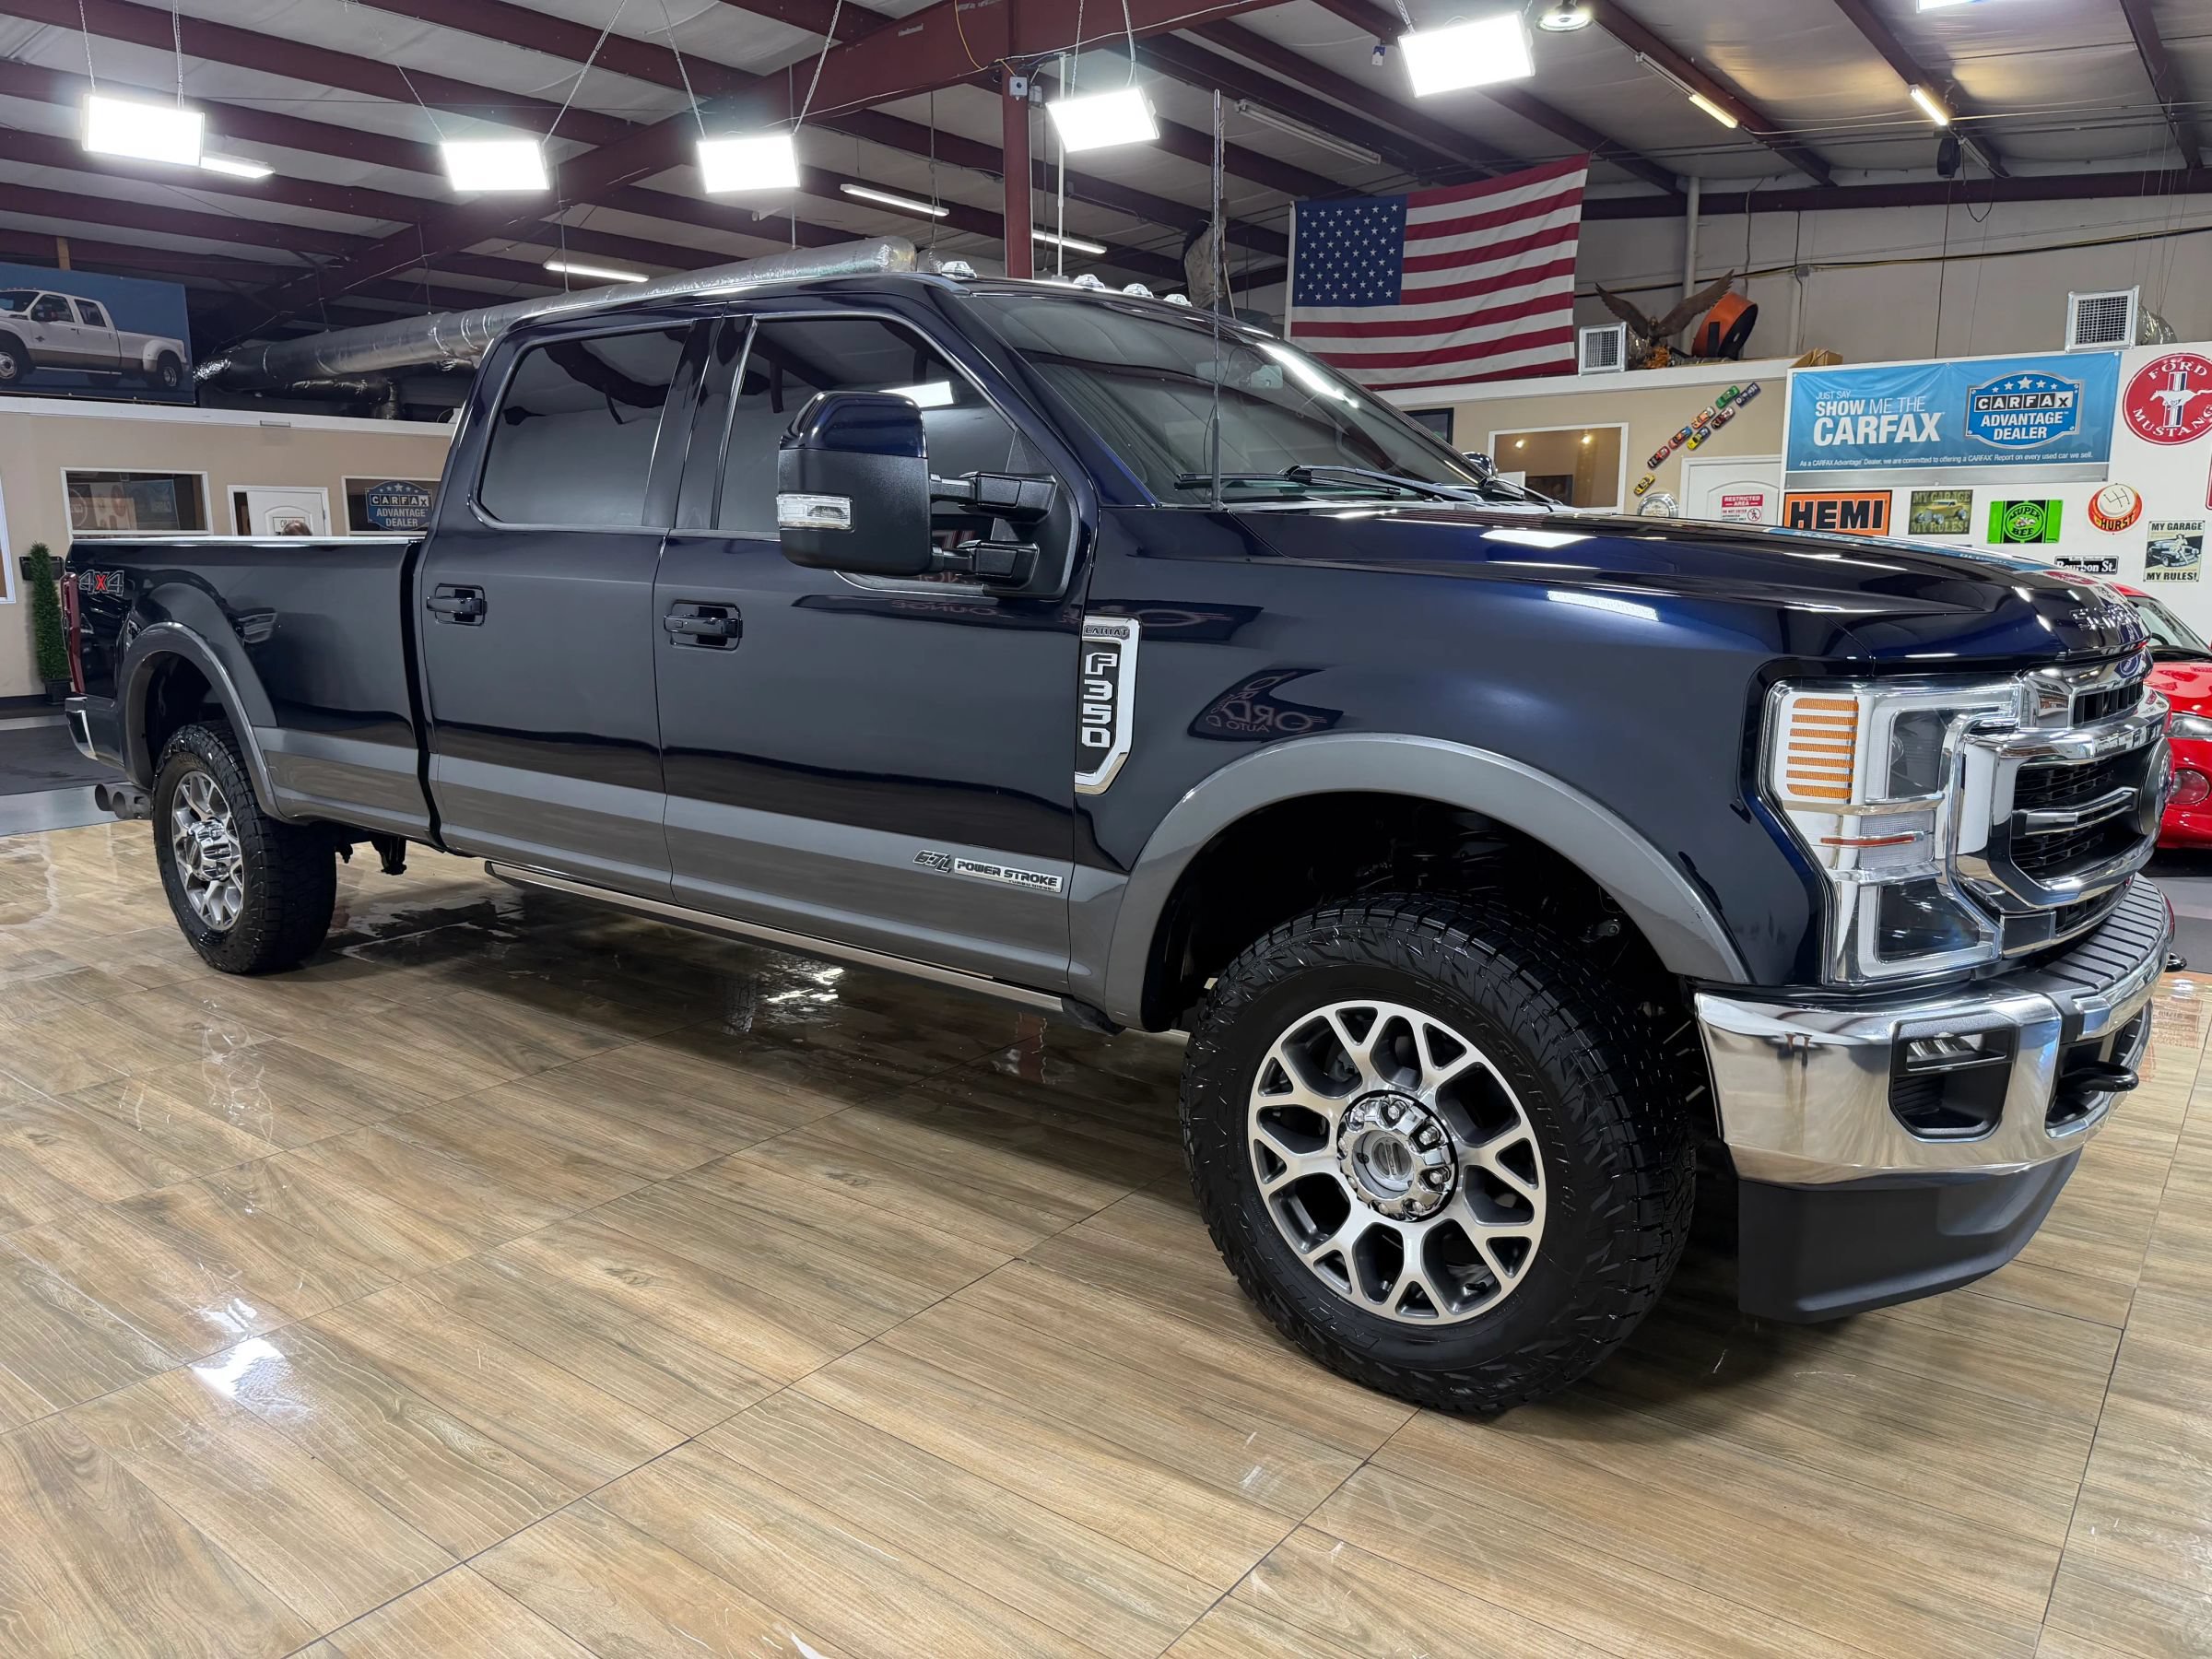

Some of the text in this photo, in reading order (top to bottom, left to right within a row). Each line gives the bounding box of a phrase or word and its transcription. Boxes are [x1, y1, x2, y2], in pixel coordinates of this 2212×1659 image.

[2147, 360, 2208, 381] FORD
[1816, 390, 1852, 400] JUST SAY
[1815, 395, 1926, 417] SHOW ME THE
[1976, 394, 2071, 411] CARFAX
[1981, 411, 2064, 427] ADVANTAGE
[2132, 404, 2212, 438] MUSTANG
[1813, 412, 1942, 447] CARFAX
[1993, 426, 2048, 441] DEALER
[1939, 455, 1961, 465] offering
[1994, 453, 2014, 462] Report
[2024, 453, 2041, 462] every
[2080, 451, 2093, 459] sell.
[371, 495, 429, 506] CARFAX
[1912, 491, 1971, 503] MY GARAGE
[376, 508, 427, 517] ADVANTAGE
[1789, 499, 1884, 531] HEMI
[2009, 507, 2041, 520] SUPER
[385, 518, 418, 527] DEALER
[1911, 521, 1969, 533] MY RULES!
[2100, 512, 2135, 531] HURST
[2151, 522, 2203, 531] MY GARAGE
[2011, 527, 2035, 535] BEE
[2101, 559, 2116, 572] St.
[2147, 571, 2197, 581] MY RULES!
[1085, 627, 1128, 637] LARIAT
[1081, 652, 1118, 748] F350
[912, 849, 952, 874] 6.7L
[957, 860, 1058, 888] POWER STROKE
